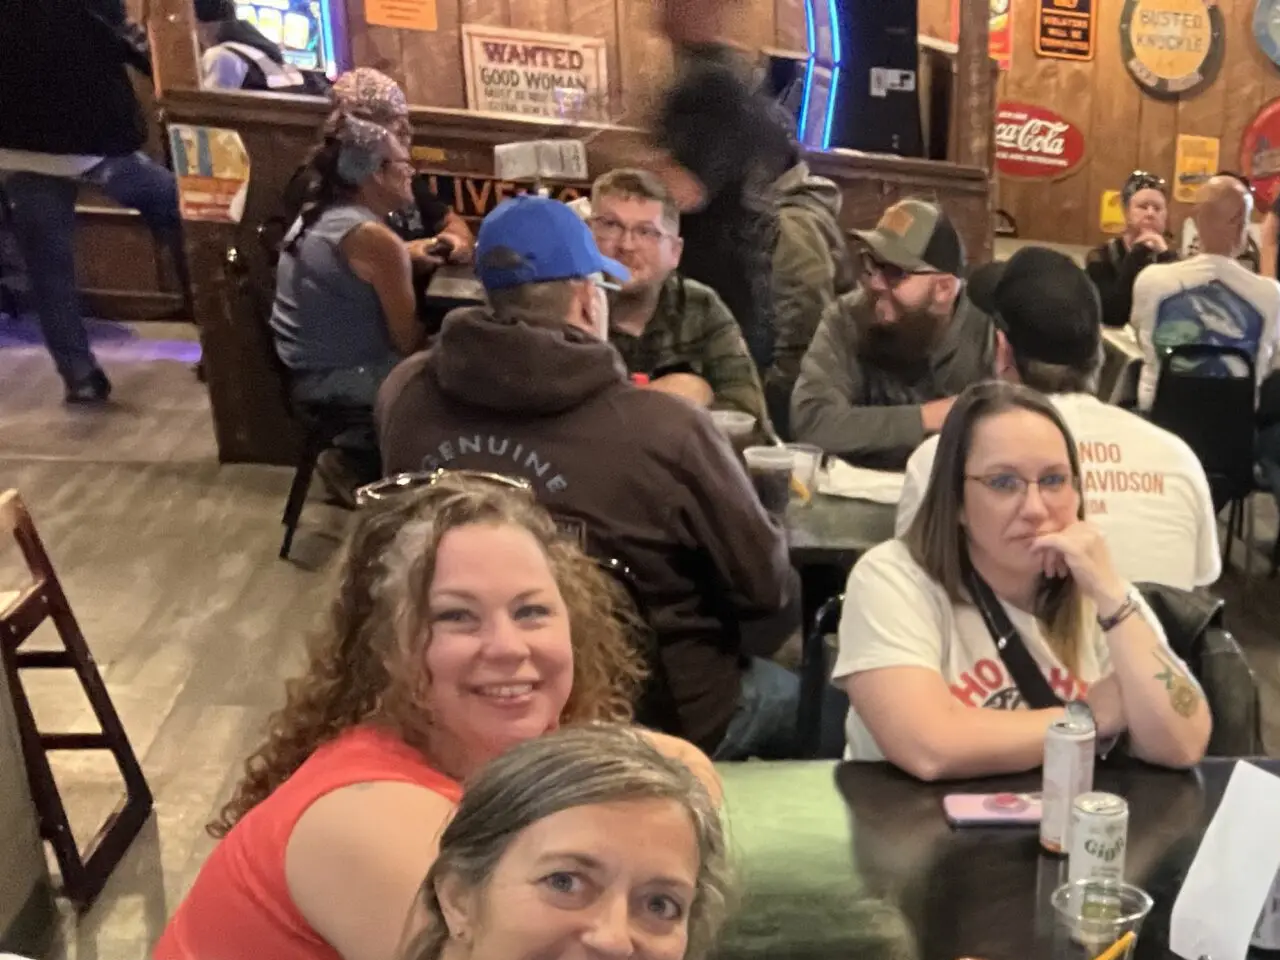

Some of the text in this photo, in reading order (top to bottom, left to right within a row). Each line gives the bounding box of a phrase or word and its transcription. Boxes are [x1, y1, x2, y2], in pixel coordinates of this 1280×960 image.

[481, 42, 584, 70] WANTED
[481, 66, 588, 90] GOOD WOMAN
[422, 434, 567, 493] GENUINE
[1079, 441, 1122, 464] NDO
[1084, 471, 1165, 494] AVIDSON
